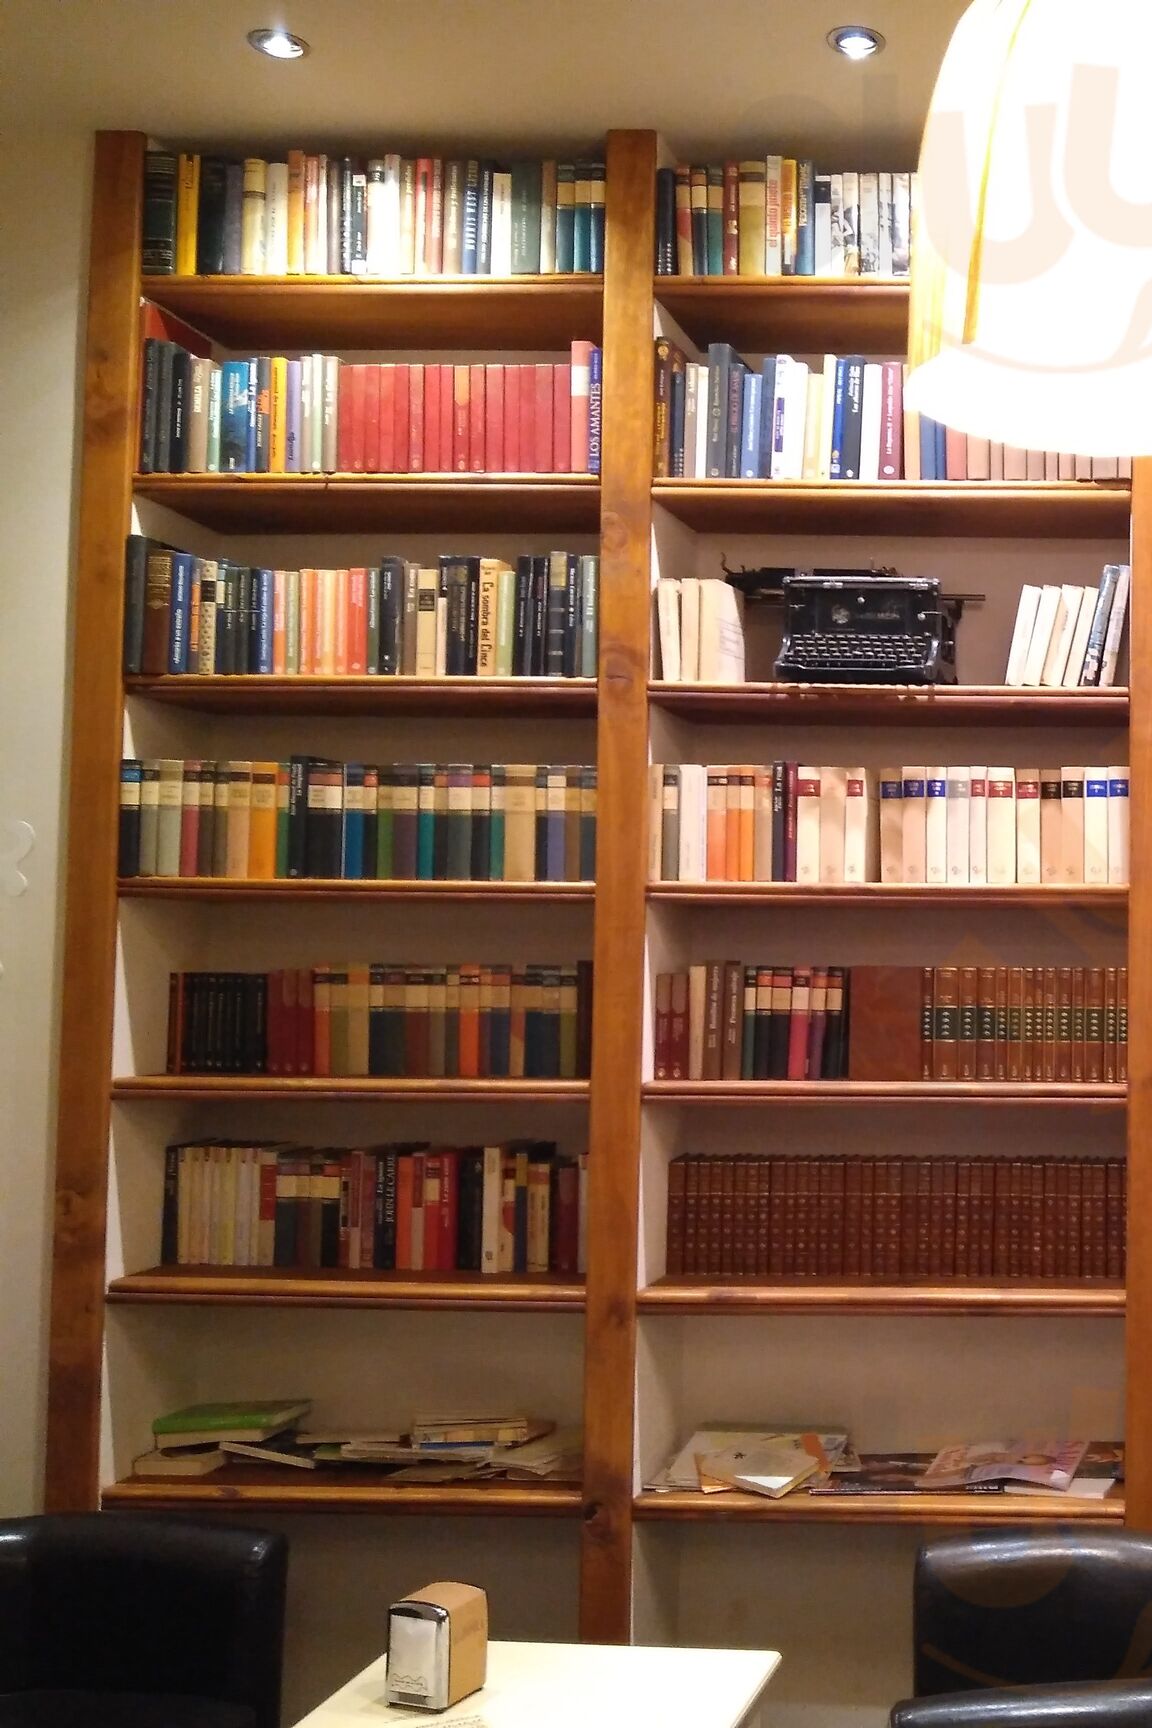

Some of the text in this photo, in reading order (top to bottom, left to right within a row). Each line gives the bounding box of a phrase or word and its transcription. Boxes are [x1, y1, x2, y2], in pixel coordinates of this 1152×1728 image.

[464, 191, 476, 213] WEST
[767, 208, 781, 238] quinto
[768, 239, 778, 248] el
[589, 383, 600, 457] LOS AMANTES
[480, 582, 495, 668] La sombra del Lince
[385, 1199, 395, 1223] JOHN
